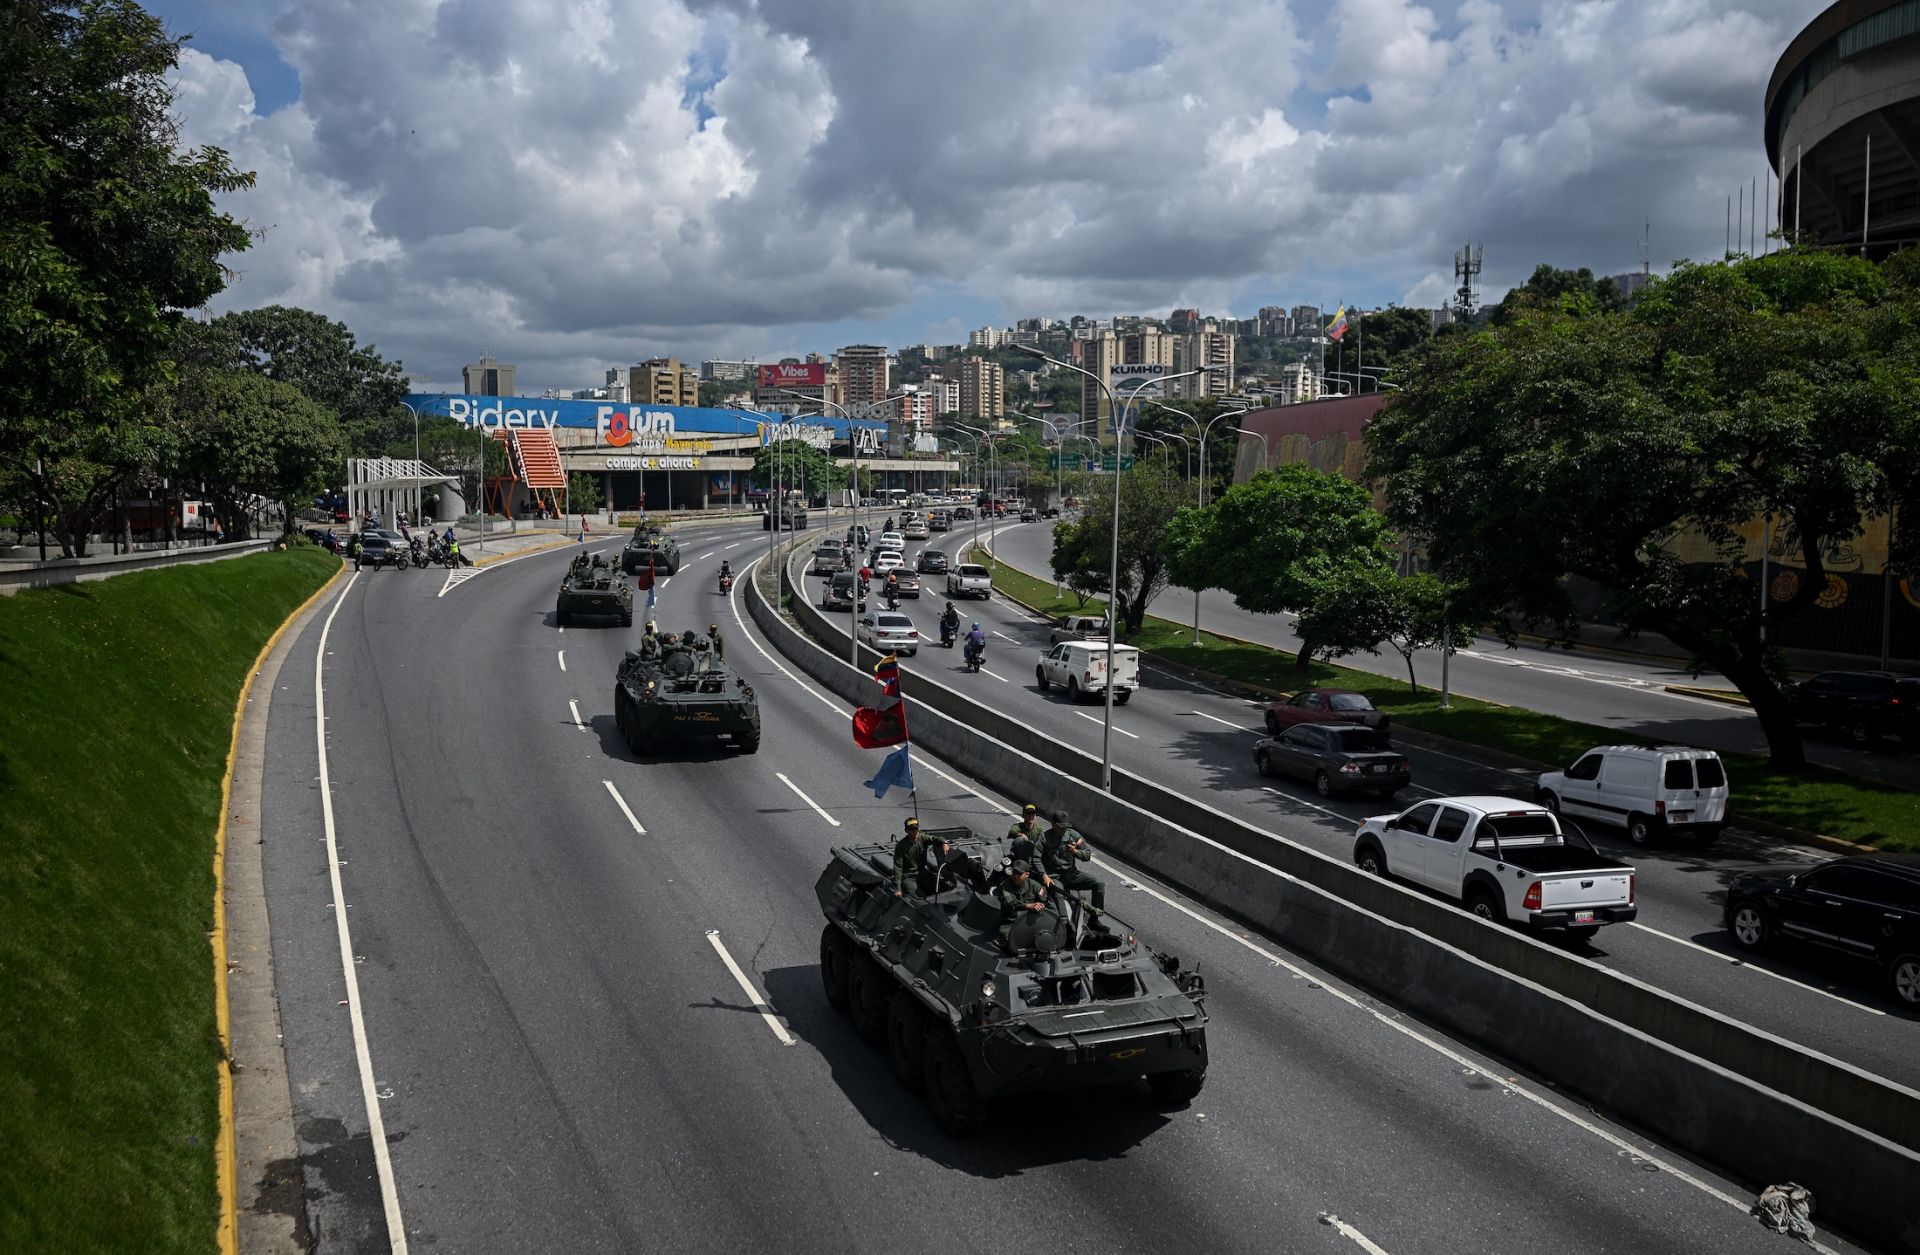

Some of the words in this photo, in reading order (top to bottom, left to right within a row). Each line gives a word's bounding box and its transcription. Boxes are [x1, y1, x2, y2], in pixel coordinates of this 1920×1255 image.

[779, 365, 809, 377] Vibes
[1110, 365, 1163, 374] KUMHO
[596, 406, 675, 437] Forum
